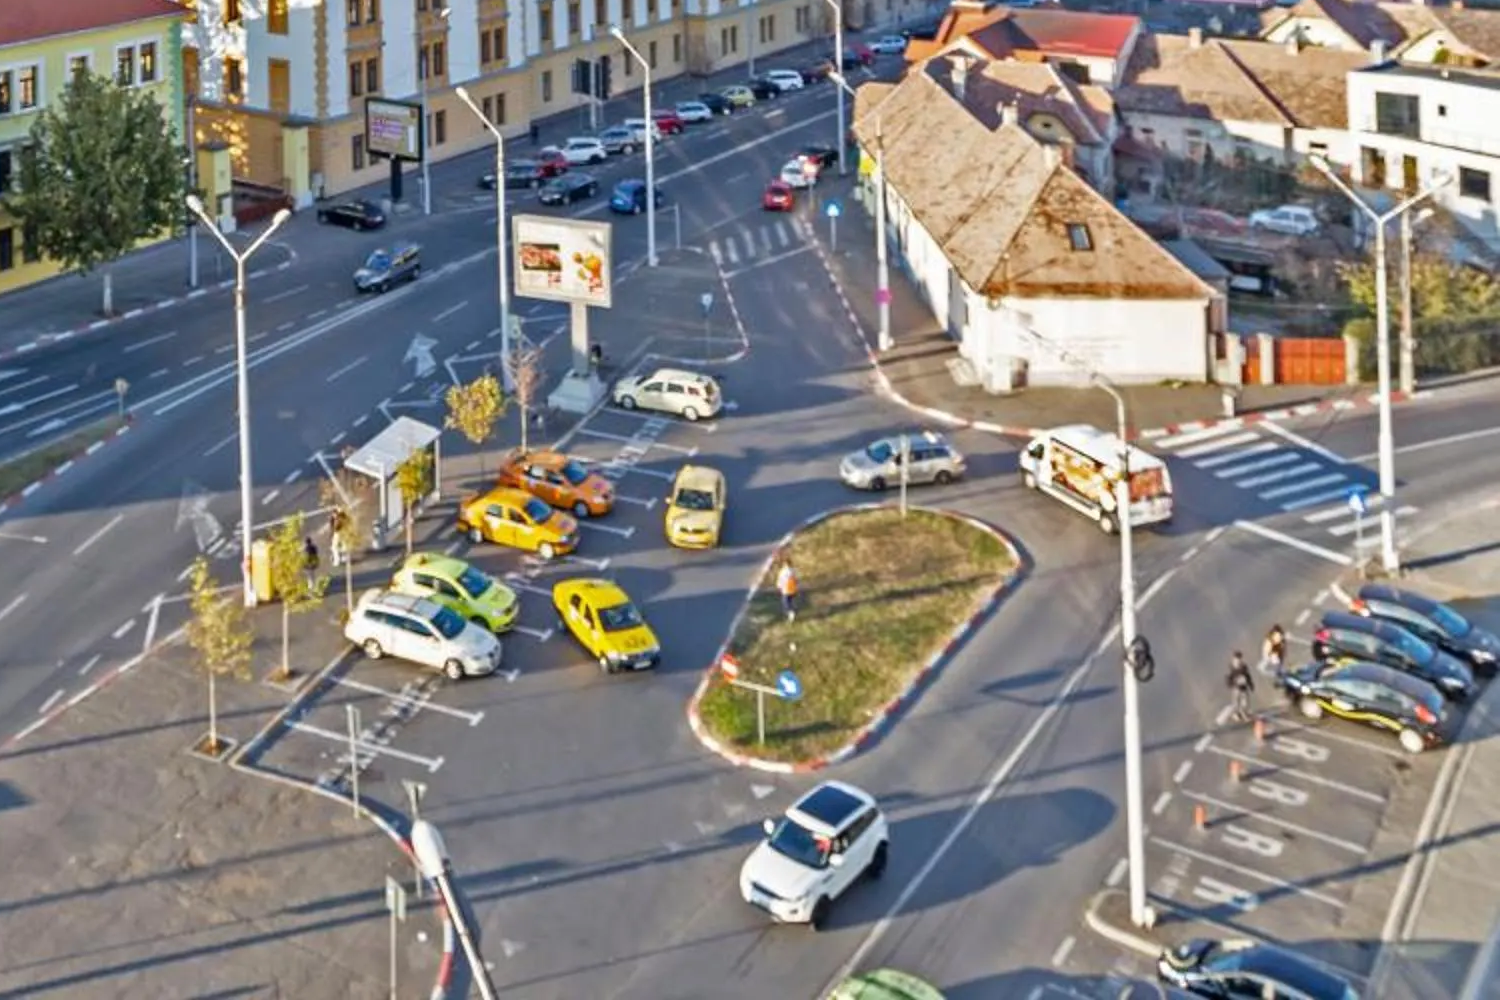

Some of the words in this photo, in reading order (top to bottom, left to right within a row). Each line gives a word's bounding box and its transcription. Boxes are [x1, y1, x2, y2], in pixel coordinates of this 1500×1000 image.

[1273, 735, 1332, 763] R
[1248, 777, 1310, 806] R
[1221, 823, 1285, 858] R
[1193, 876, 1259, 911] R
